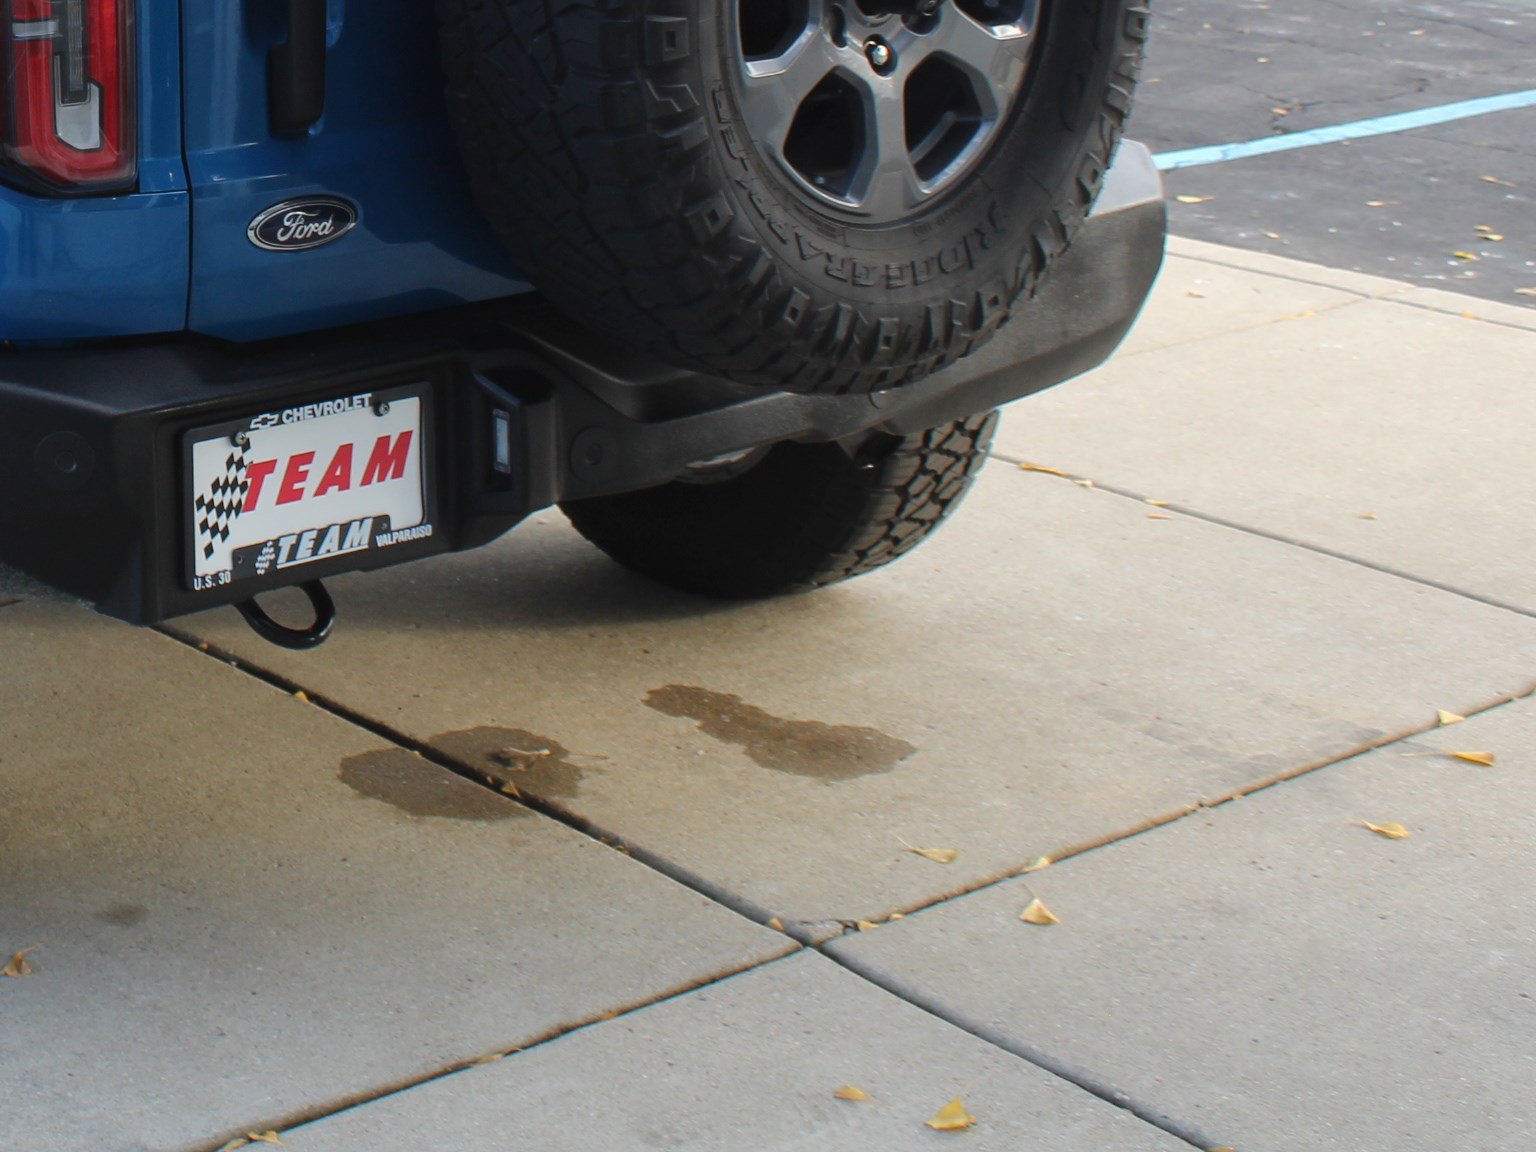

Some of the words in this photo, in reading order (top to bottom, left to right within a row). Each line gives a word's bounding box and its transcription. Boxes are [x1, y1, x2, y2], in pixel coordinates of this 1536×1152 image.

[276, 210, 334, 242] Ford
[281, 393, 372, 425] CHEVROLET
[241, 430, 414, 514] TEAM
[277, 517, 373, 564] TEAM
[376, 524, 433, 548] VALPARAISO
[194, 575, 216, 591] U.S.
[218, 571, 232, 585] 30
